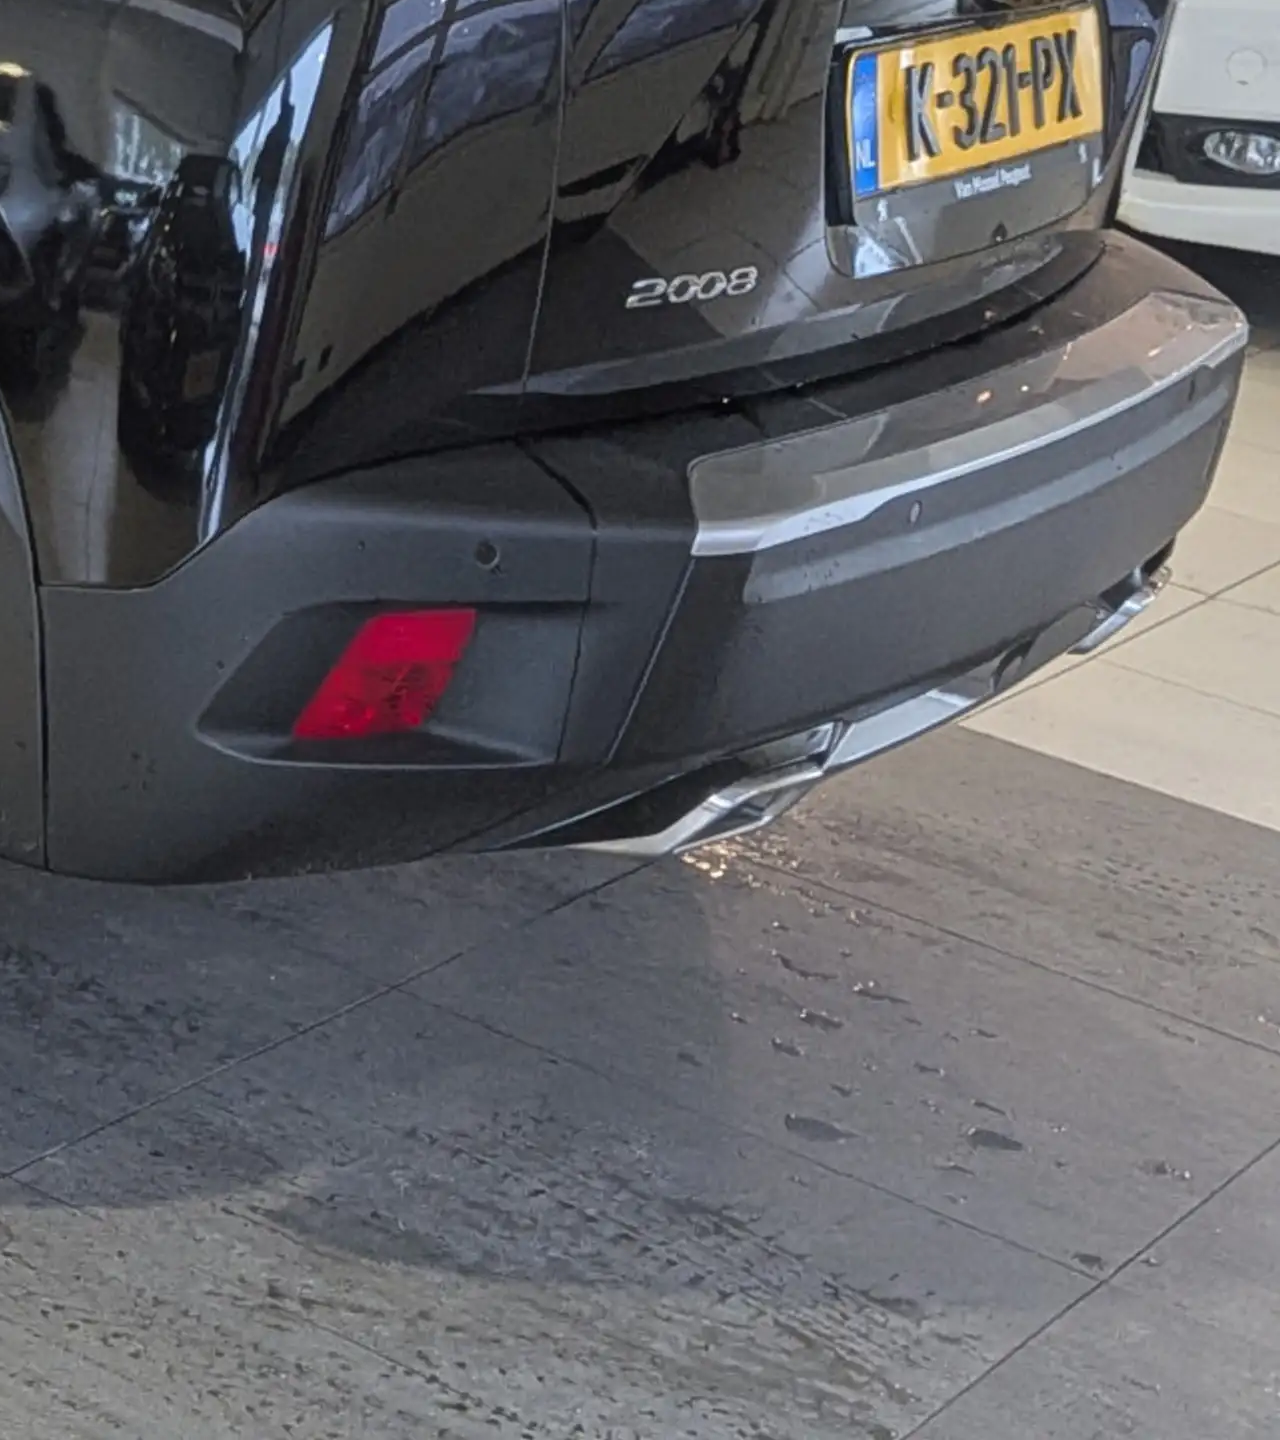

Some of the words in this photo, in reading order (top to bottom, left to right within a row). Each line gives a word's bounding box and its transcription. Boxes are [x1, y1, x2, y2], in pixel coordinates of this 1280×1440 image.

[904, 28, 1082, 163] K-321-PX
[855, 138, 876, 171] NL
[625, 265, 758, 309] 2008
